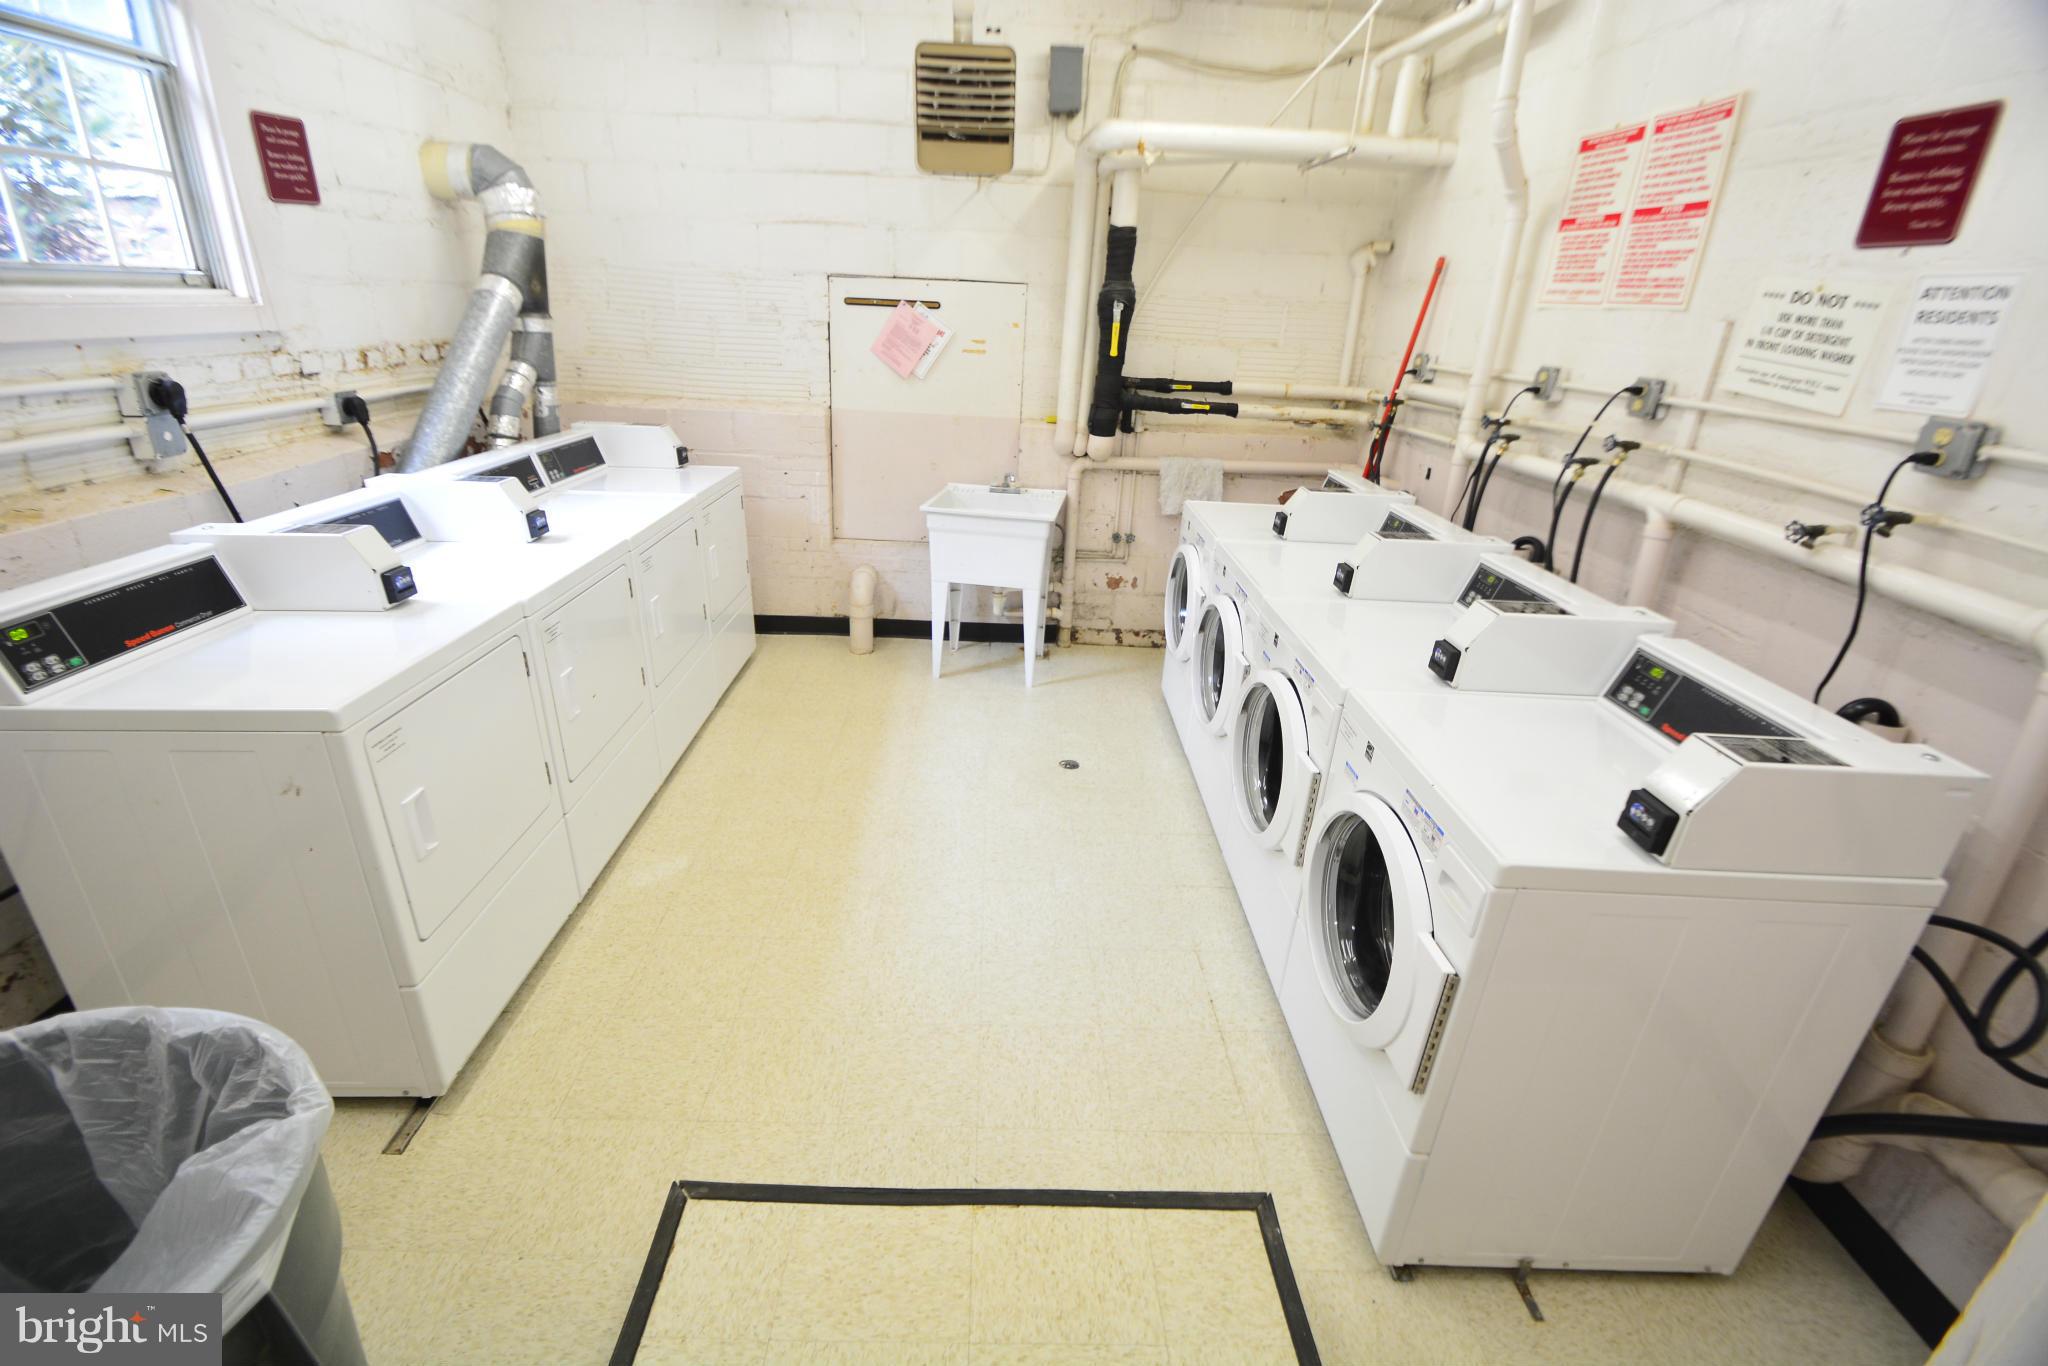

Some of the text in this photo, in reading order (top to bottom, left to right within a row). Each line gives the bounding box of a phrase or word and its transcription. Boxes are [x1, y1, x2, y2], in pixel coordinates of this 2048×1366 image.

[1790, 290, 1849, 309] DO NOT
[1919, 286, 2011, 299] ATTENTION
[1794, 314, 1819, 326] MORE
[1915, 310, 1999, 325] RESIDENTS
[1804, 332, 1852, 346] DETERGENT
[1755, 339, 1781, 351] FRONT
[1780, 344, 1817, 359] LOADING
